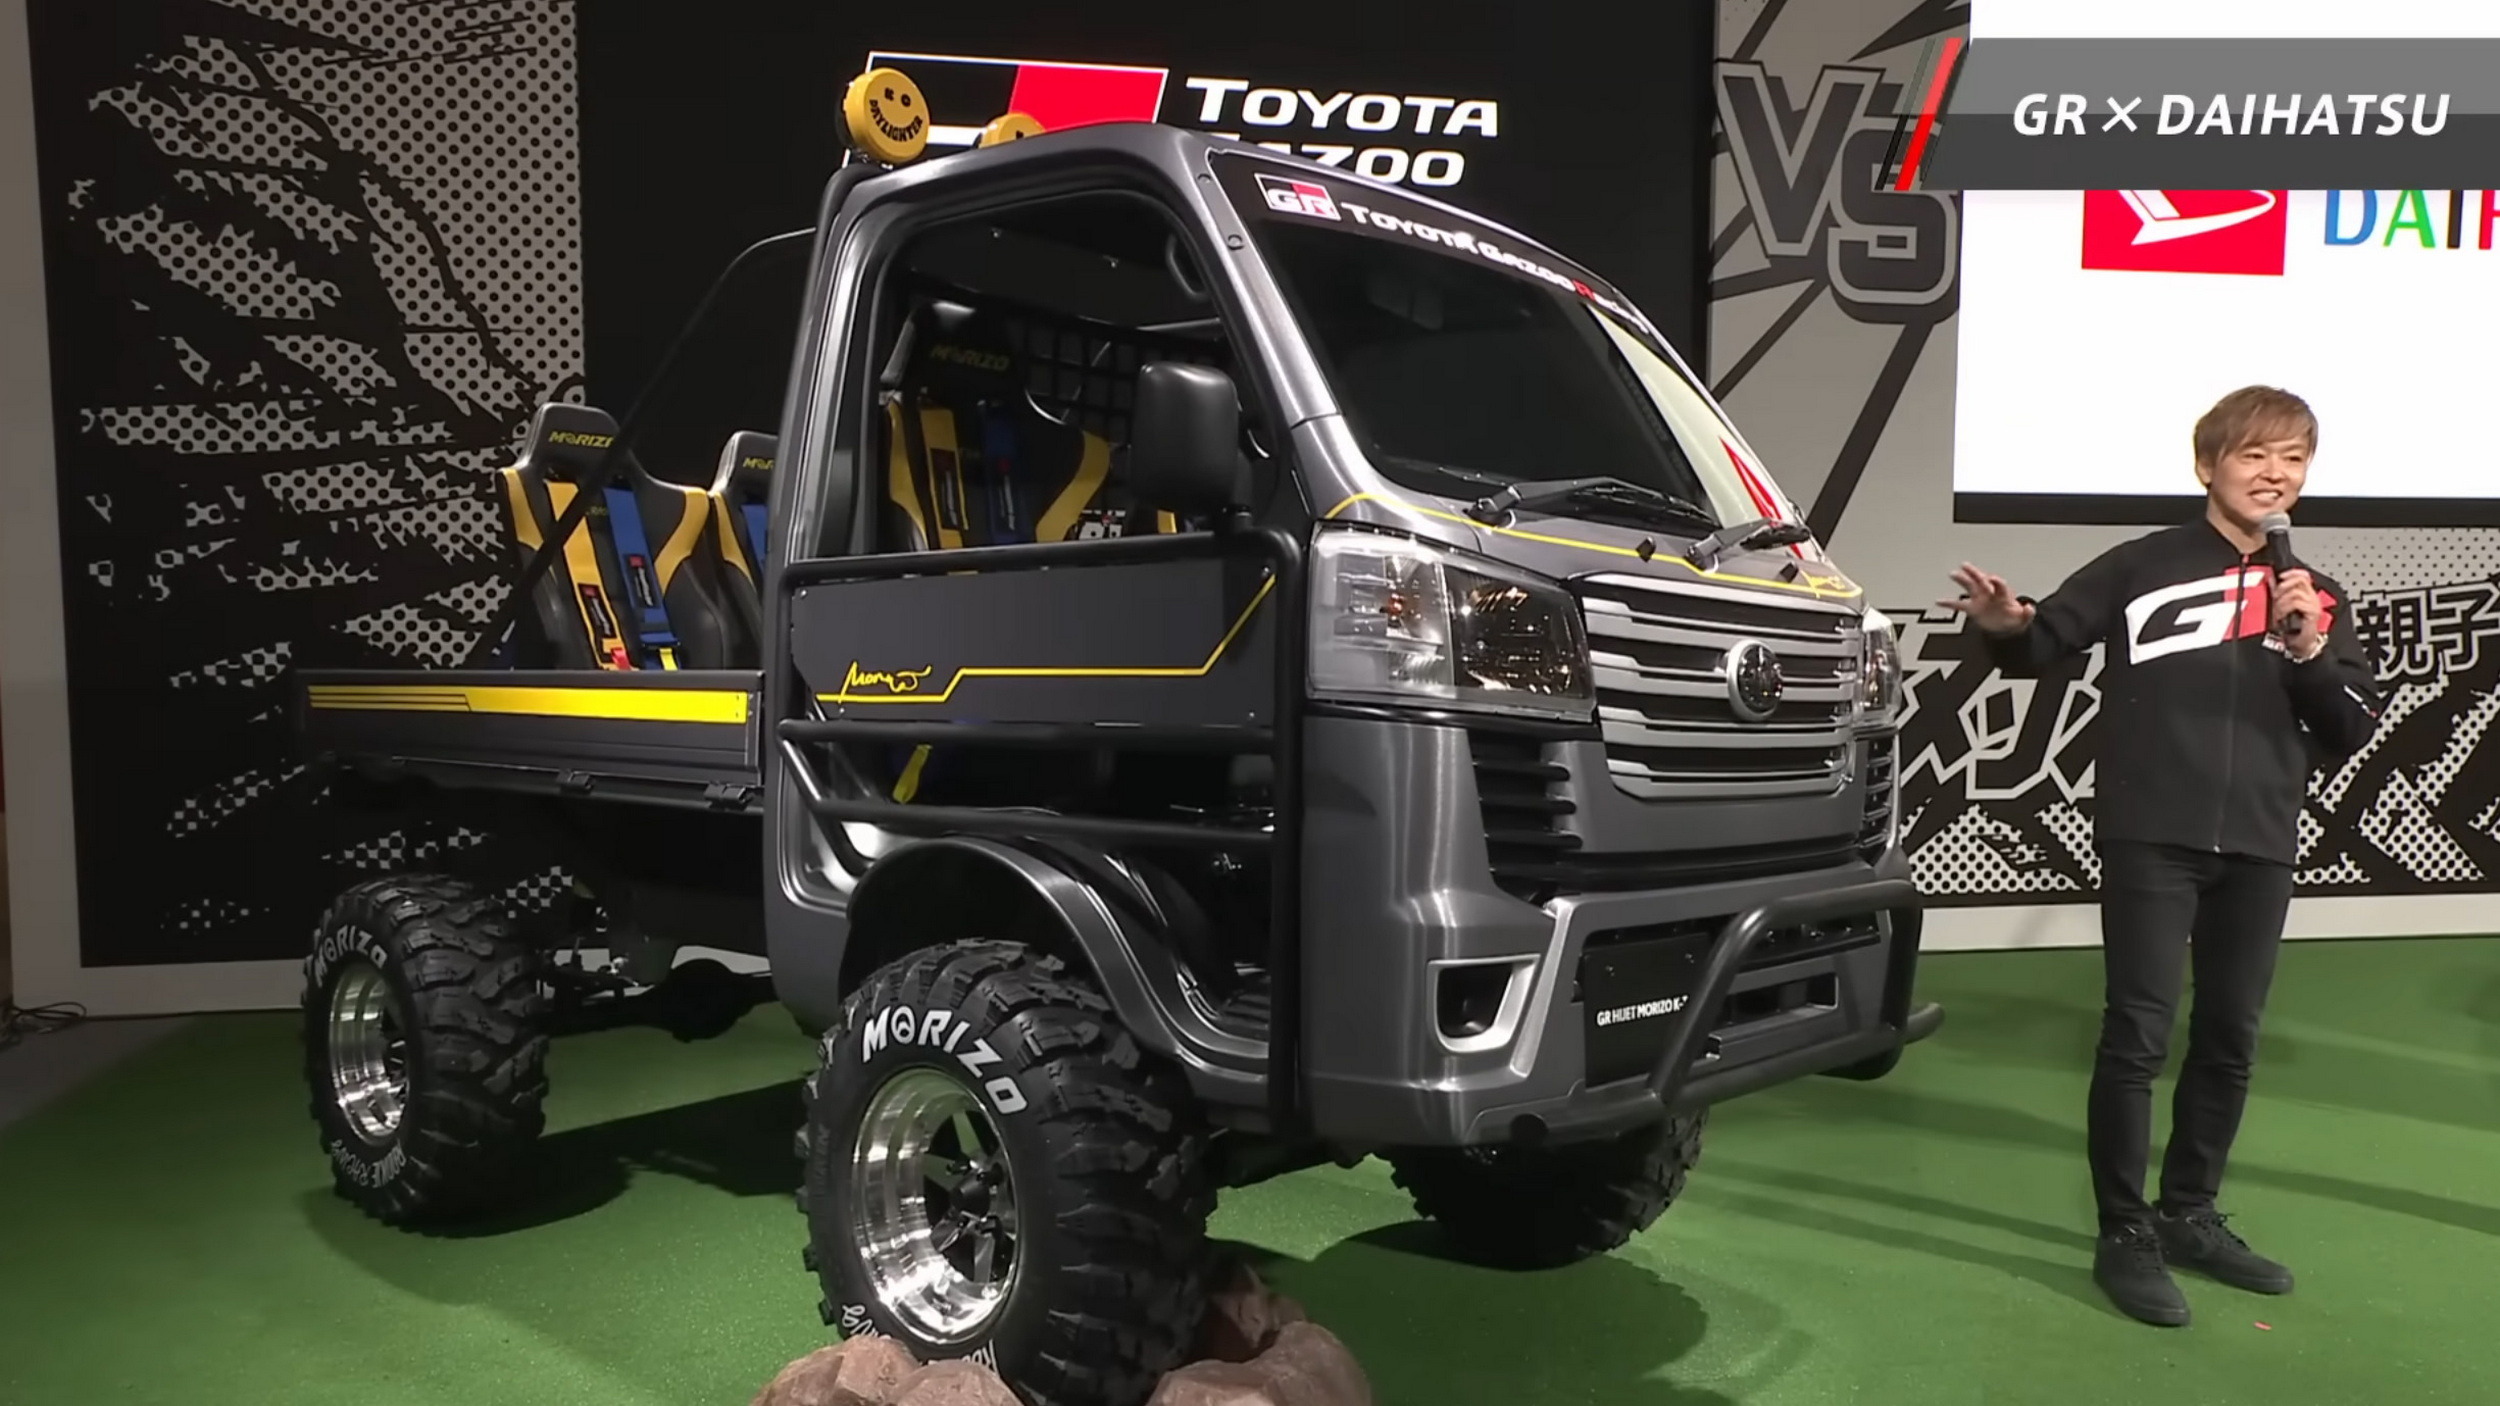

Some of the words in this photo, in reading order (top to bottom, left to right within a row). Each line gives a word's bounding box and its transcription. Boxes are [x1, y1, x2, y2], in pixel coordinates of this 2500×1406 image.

[869, 99, 924, 143] DAYLIGHTER
[1186, 77, 1498, 137] TOYOTA
[1713, 62, 1958, 306] VS
[1266, 187, 1336, 217] GR
[1340, 201, 1479, 255] TOYOTA
[2351, 583, 2500, 681] 親子
[314, 923, 388, 989] MORIZO
[1596, 1010, 1612, 1027] GR
[1637, 998, 1673, 1019] MORIZO
[862, 1004, 1028, 1115] MORIZO
